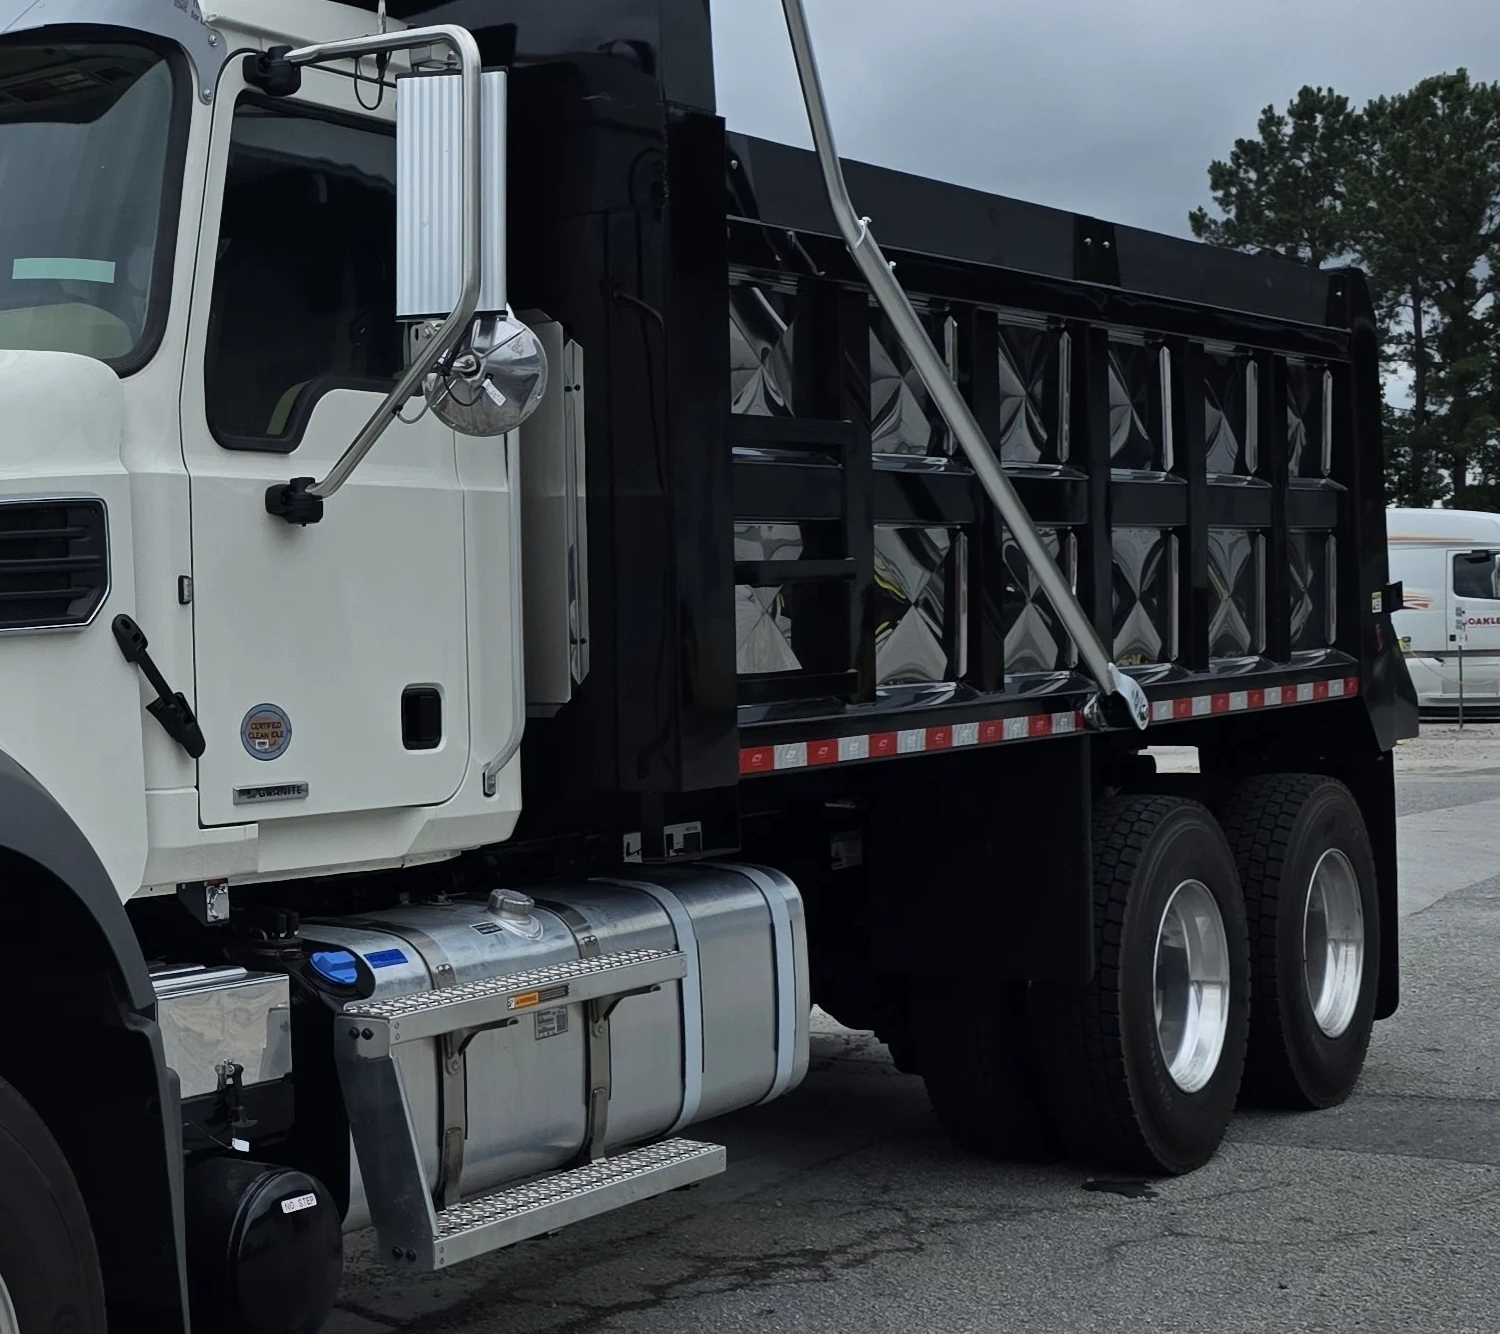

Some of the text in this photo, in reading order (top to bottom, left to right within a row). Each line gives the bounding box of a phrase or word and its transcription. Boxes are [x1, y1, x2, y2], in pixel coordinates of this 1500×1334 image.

[259, 785, 302, 798] GRANITE
[284, 1196, 314, 1212] NO STEP
